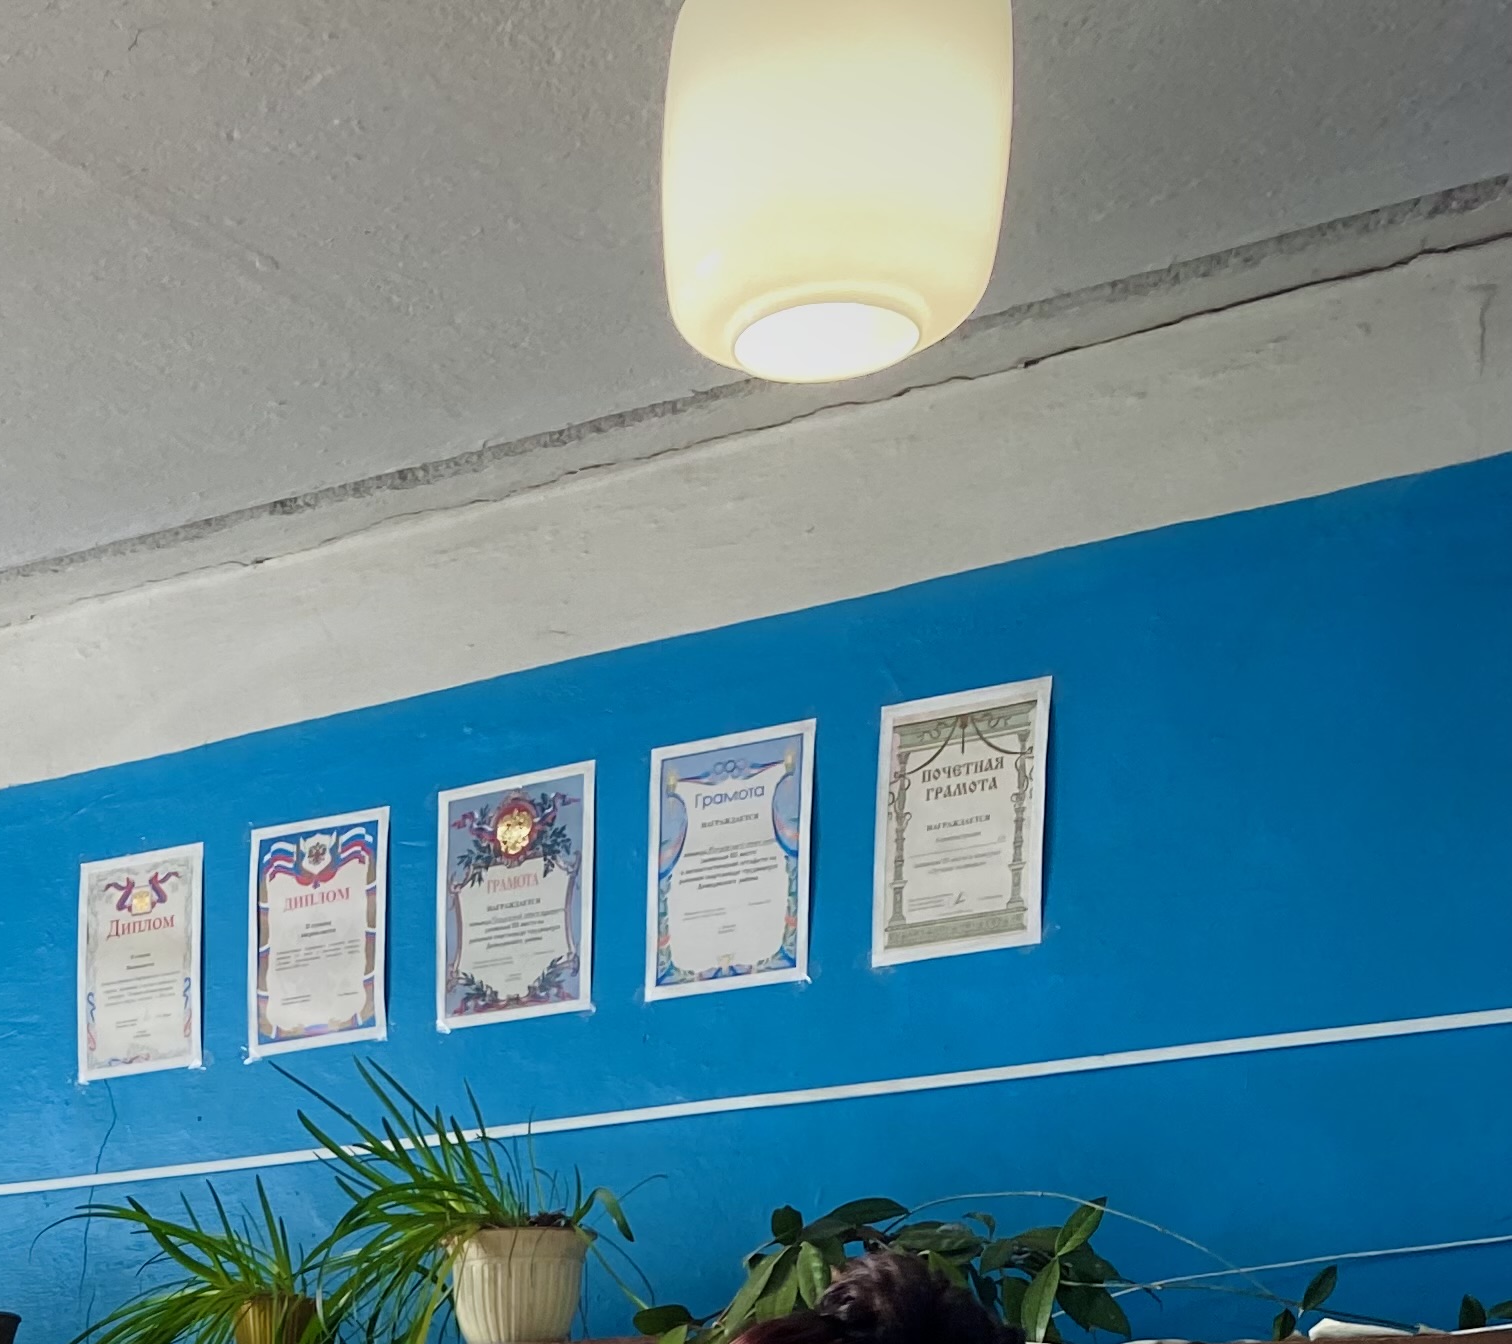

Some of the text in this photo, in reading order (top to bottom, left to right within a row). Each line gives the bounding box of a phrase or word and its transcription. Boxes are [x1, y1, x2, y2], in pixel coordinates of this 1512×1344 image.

[921, 756, 1004, 783] ПОЧЕТНАЯ
[694, 785, 765, 809] Грамота
[925, 777, 998, 801] ГРАМОТА
[487, 872, 539, 894] ГРАМОТА
[283, 887, 351, 912] ДИПЛОМ
